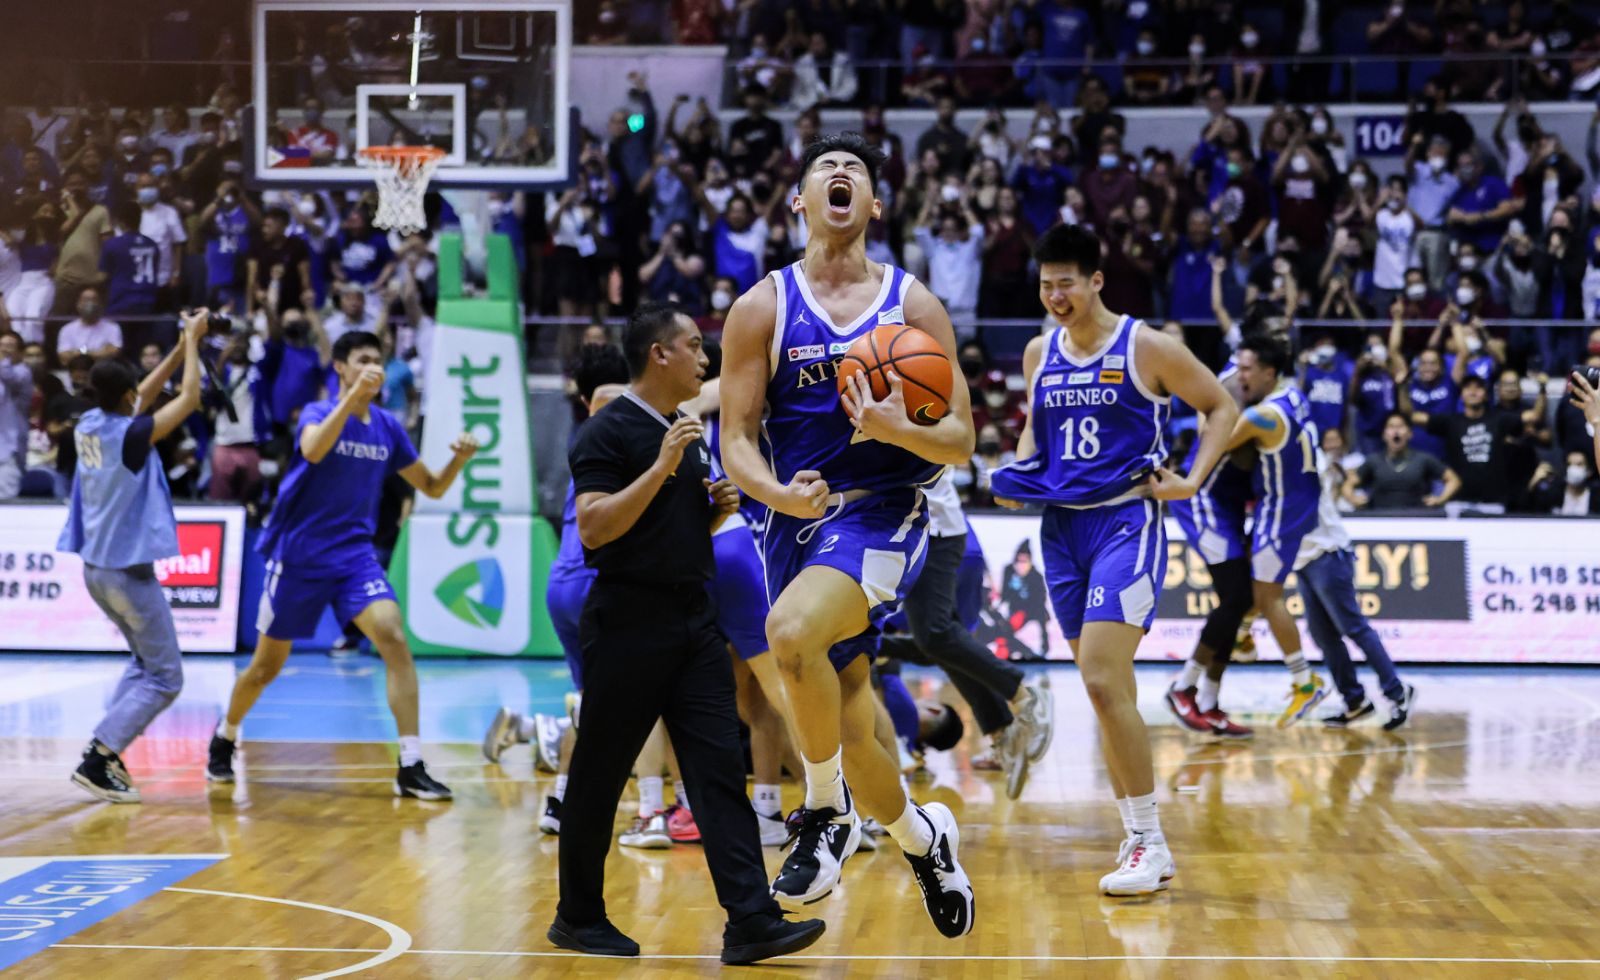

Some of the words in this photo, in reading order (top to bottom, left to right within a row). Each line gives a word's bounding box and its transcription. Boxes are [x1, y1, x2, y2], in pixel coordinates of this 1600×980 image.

[1044, 387, 1118, 408] ATENEO
[1059, 416, 1101, 460] 18
[335, 439, 390, 462] ATENEO
[818, 534, 840, 554] 2
[25, 553, 55, 572] SD
[1483, 565, 1522, 584] Ch.
[1531, 566, 1568, 585] 198
[28, 582, 62, 600] HD
[1086, 585, 1105, 609] 18
[1484, 592, 1524, 612] Ch.
[1532, 594, 1576, 612] 298
